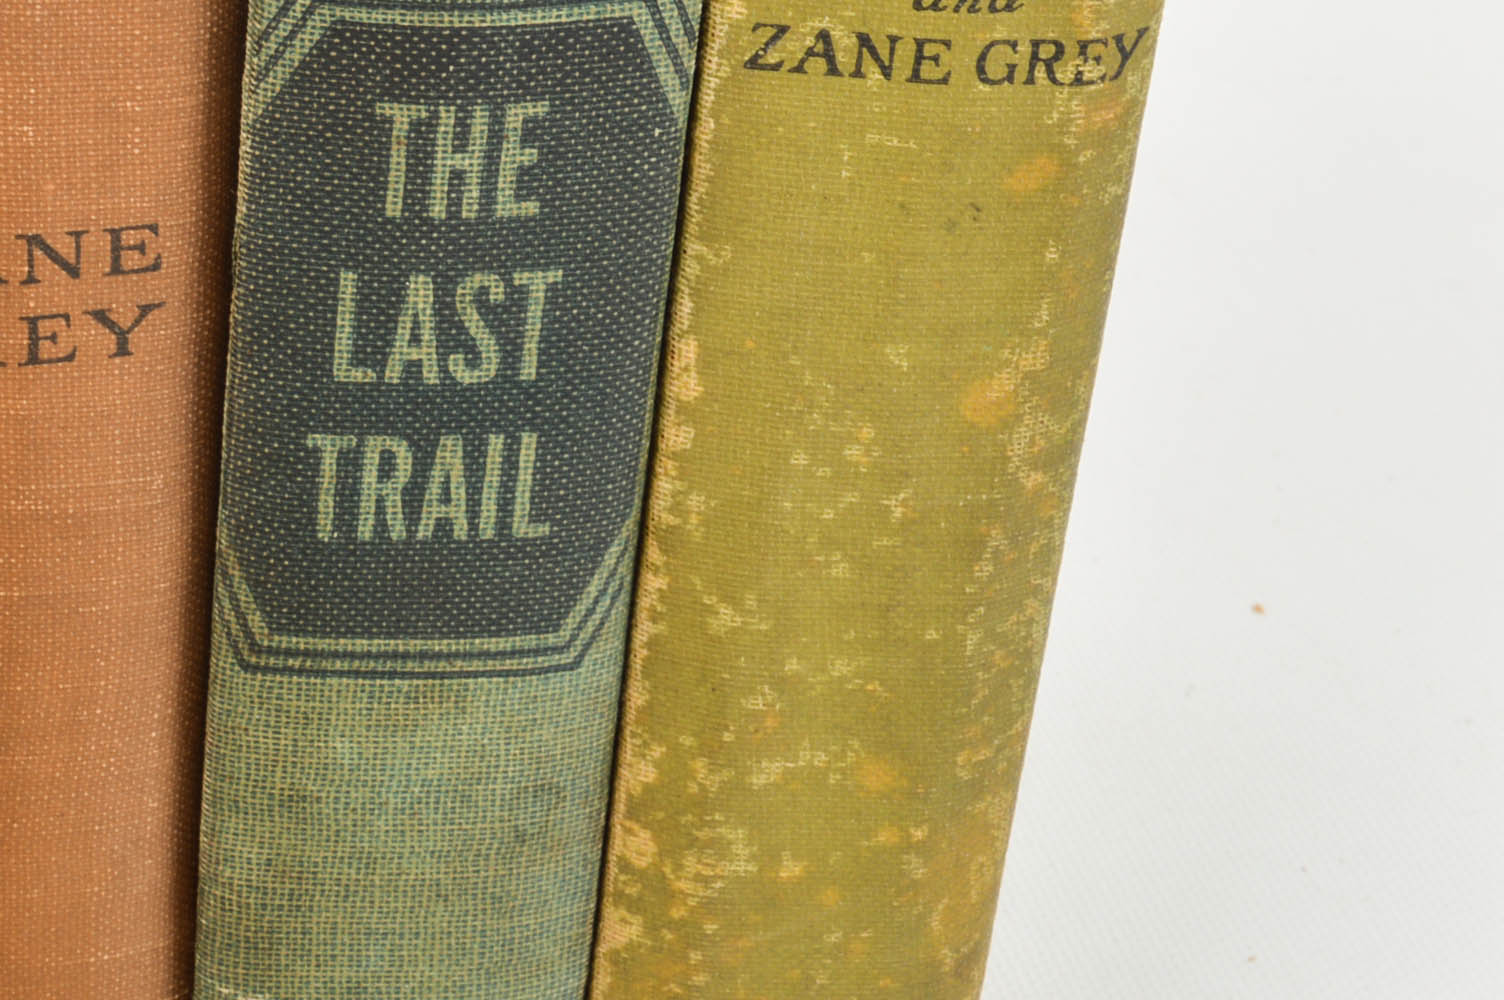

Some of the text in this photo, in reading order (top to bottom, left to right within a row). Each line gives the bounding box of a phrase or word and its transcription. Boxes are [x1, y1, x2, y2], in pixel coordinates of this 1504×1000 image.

[743, 22, 1151, 87] ZANE GREY
[376, 101, 551, 220] THE
[333, 268, 564, 385] LAST
[306, 432, 552, 542] TRAIL
